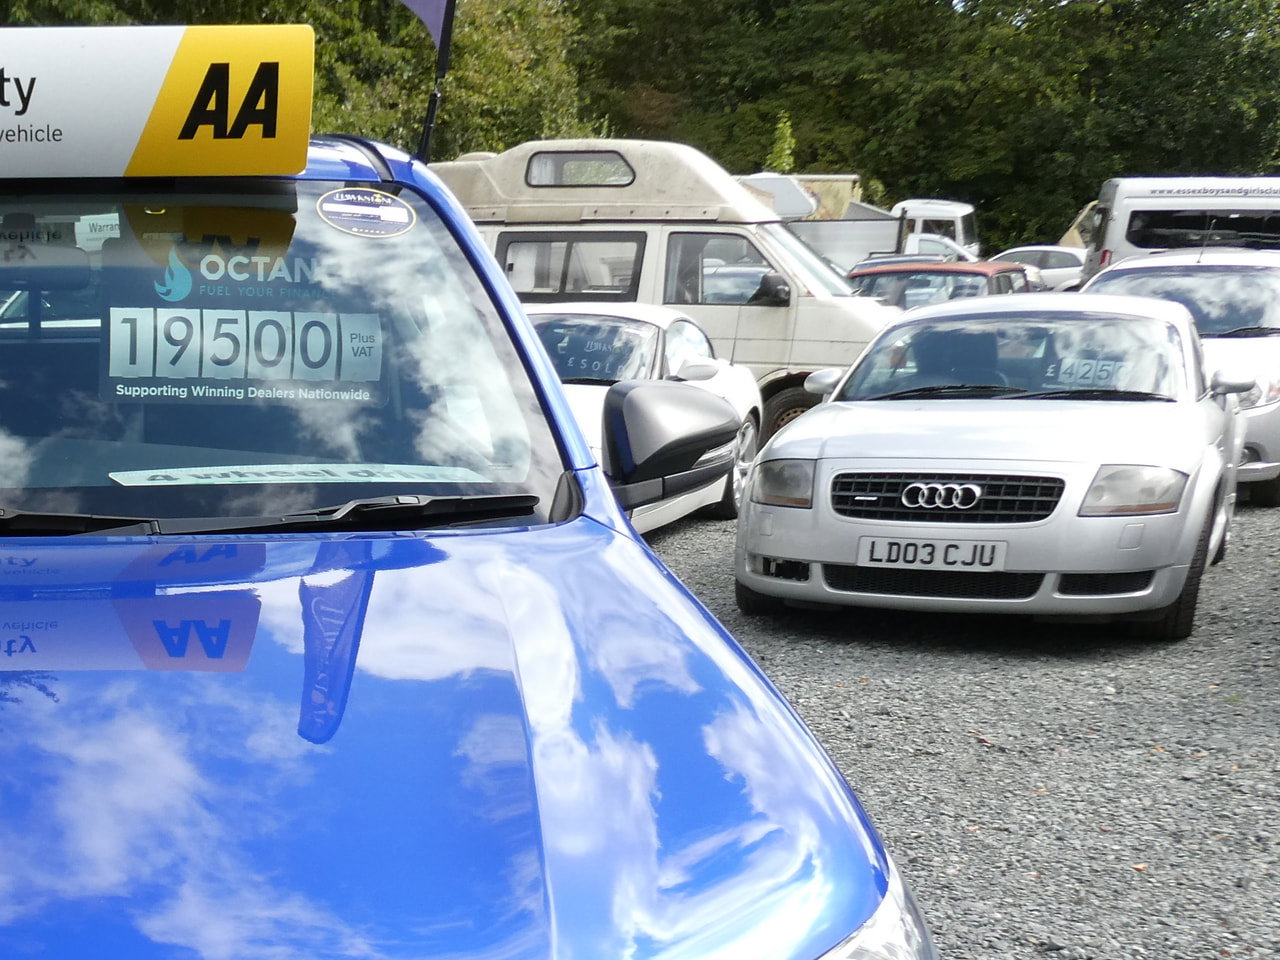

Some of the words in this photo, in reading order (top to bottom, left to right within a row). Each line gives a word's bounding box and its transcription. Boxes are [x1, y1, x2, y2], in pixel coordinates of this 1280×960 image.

[177, 61, 280, 141] AA
[1150, 186, 1280, 196] www.essexboysandgirlsclu
[199, 254, 320, 283] OCTAN
[199, 285, 231, 296] FUEL
[238, 286, 273, 298] YOUR
[120, 315, 332, 370] 19500
[350, 332, 376, 344] Plus
[351, 346, 375, 358] VAT
[115, 384, 188, 398] Supporting
[191, 385, 244, 399] Winning
[248, 387, 294, 399] Dealers
[298, 388, 370, 400] Nationwide
[187, 468, 341, 480] wheel
[869, 541, 935, 565] LD03
[943, 544, 996, 567] CJU
